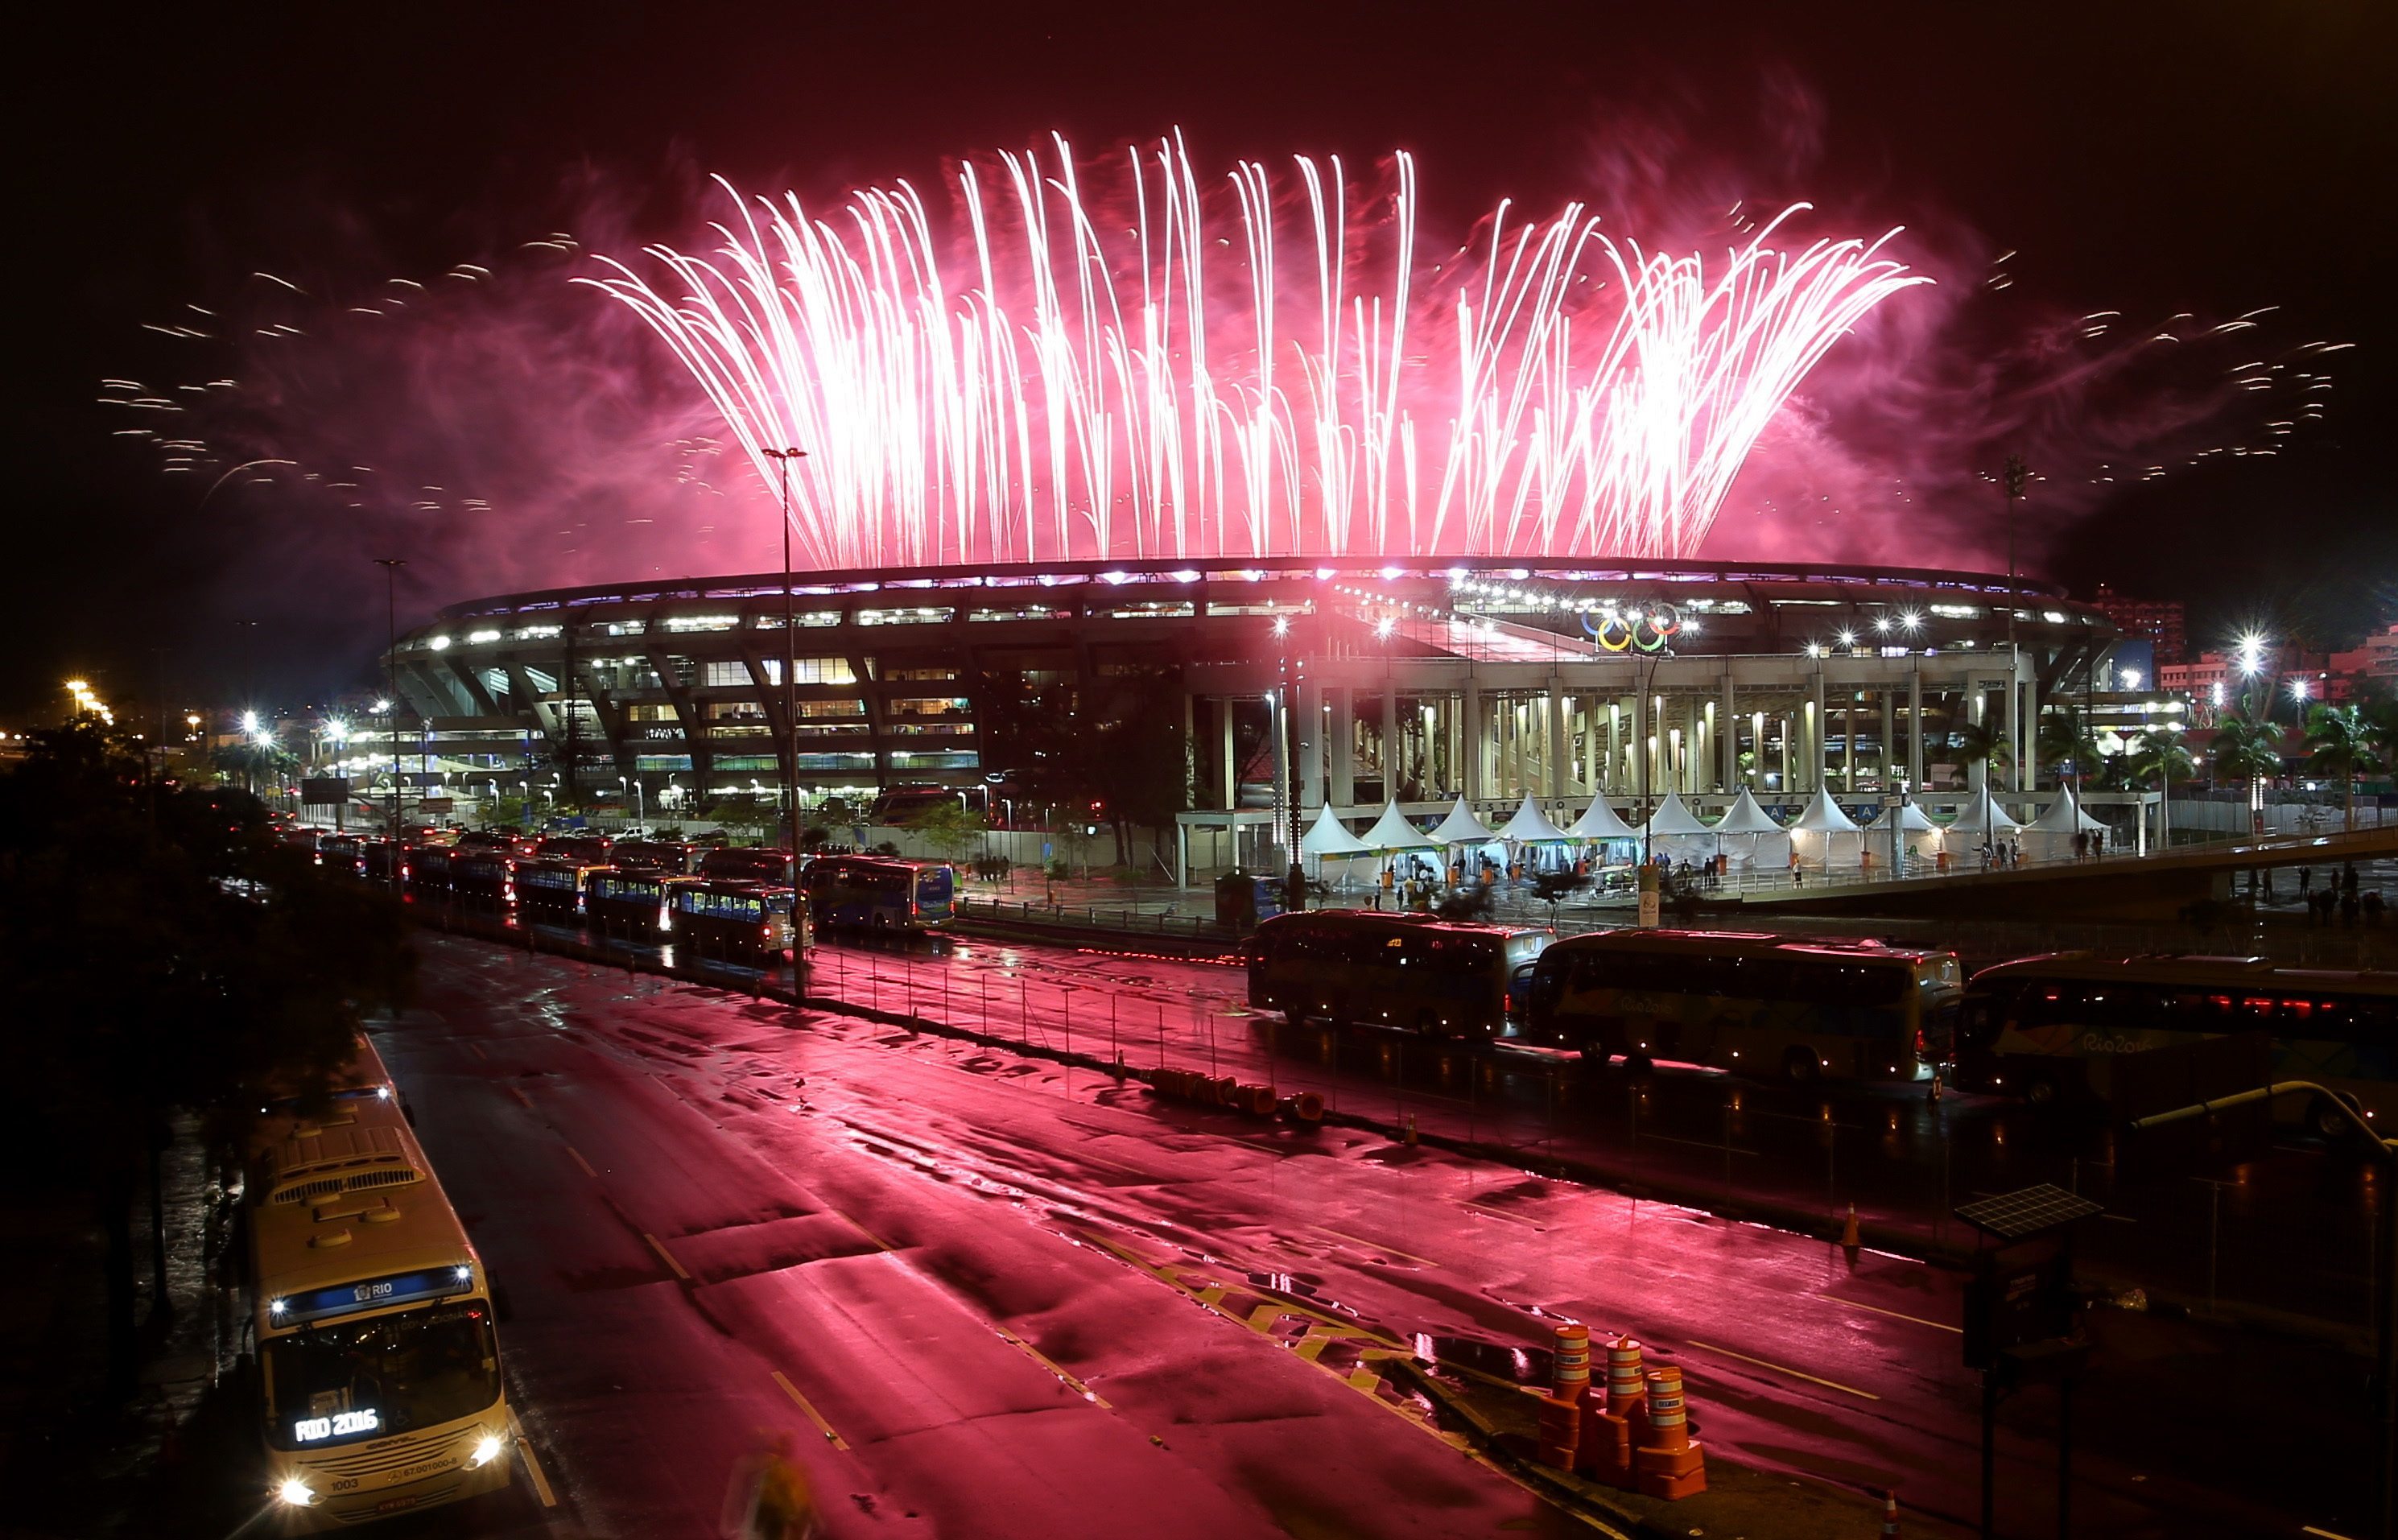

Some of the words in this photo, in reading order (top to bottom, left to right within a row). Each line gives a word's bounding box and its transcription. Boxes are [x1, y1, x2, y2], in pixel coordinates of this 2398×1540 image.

[1474, 801, 1565, 811] ESTÁIO
[1634, 798, 1701, 807] MAIO
[1774, 795, 1843, 805] FILO
[1771, 807, 1780, 818] A
[1863, 806, 1872, 817] A
[1430, 816, 1438, 827] A
[372, 1282, 393, 1296] RIO
[295, 1417, 331, 1442] RIO
[332, 1408, 378, 1435] 2016
[331, 1479, 359, 1491] 1003
